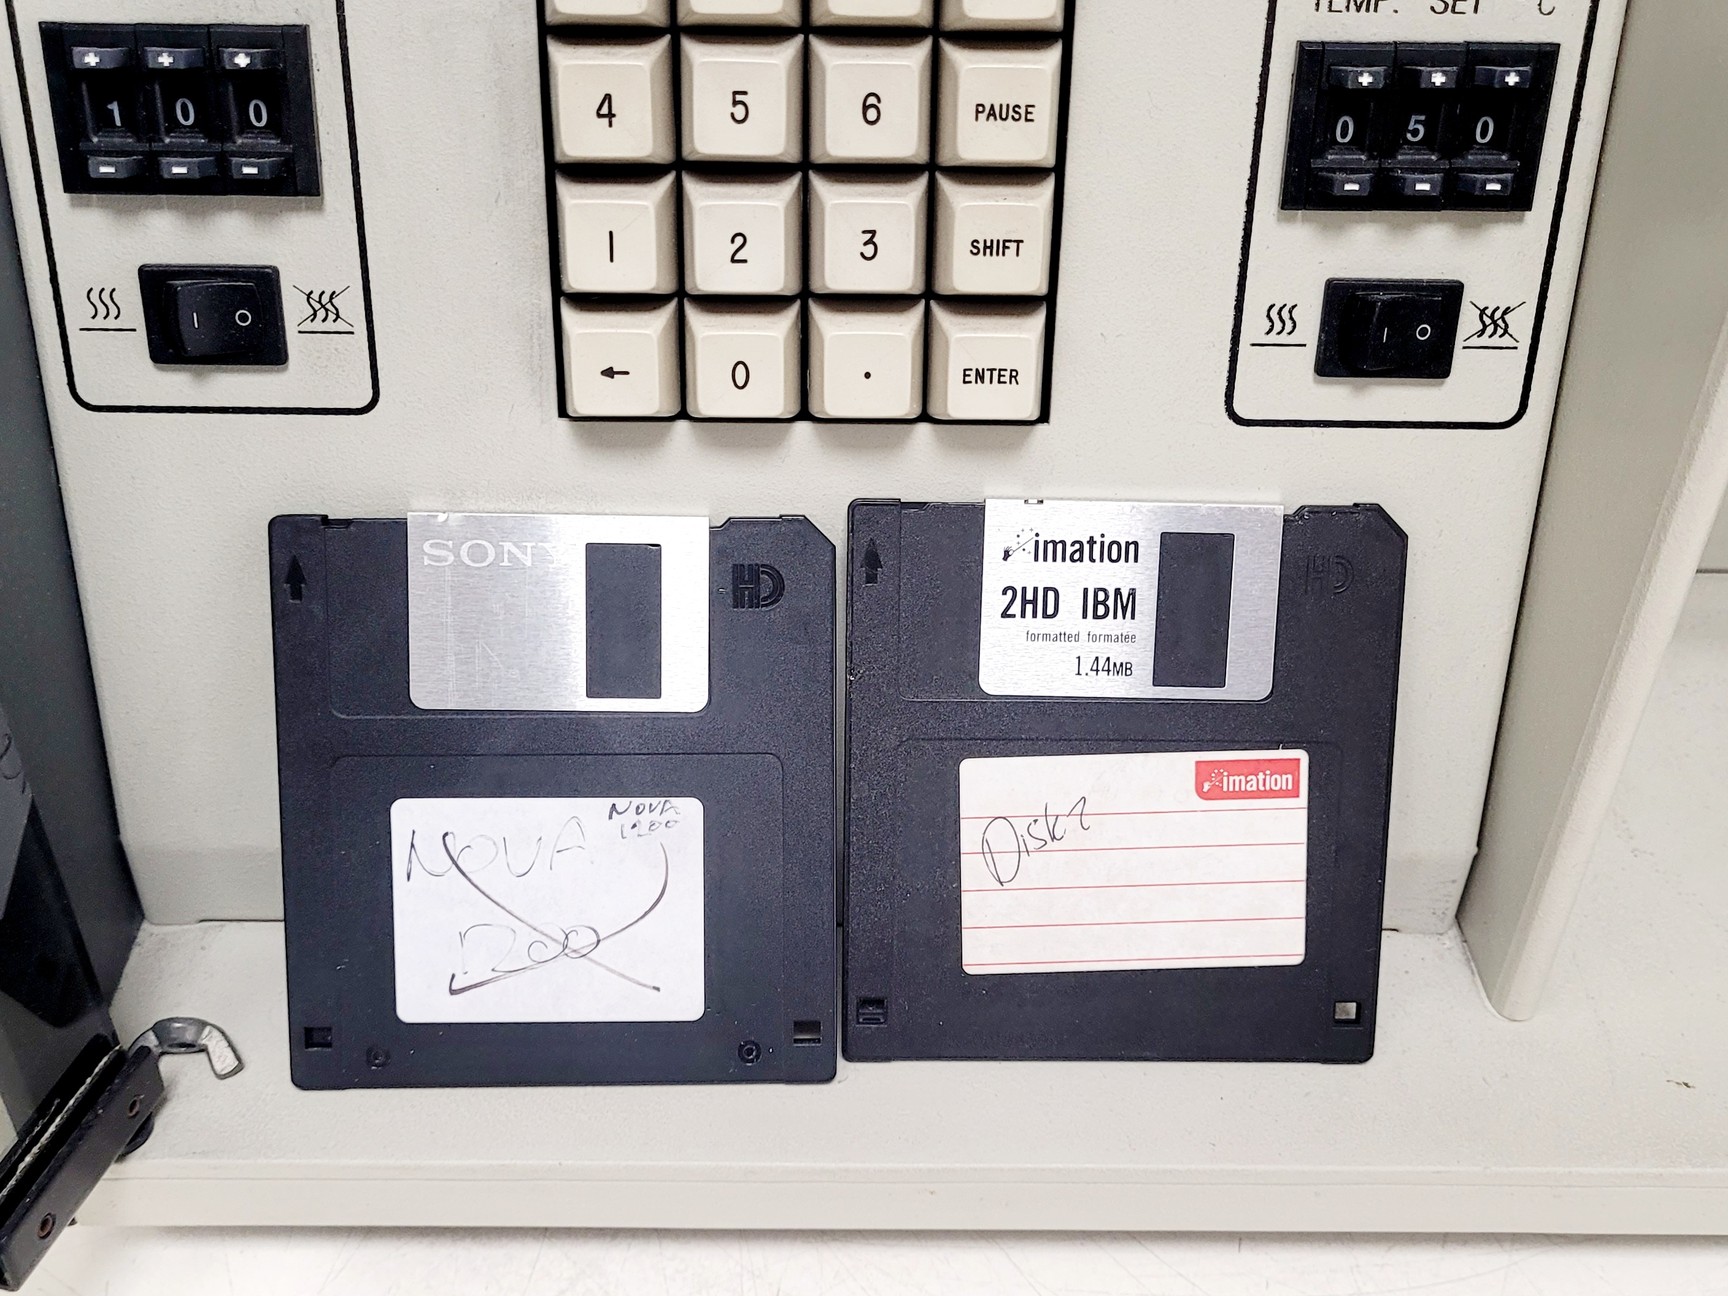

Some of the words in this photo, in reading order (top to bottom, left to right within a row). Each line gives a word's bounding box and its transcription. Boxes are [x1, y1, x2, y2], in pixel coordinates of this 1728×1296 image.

[595, 93, 617, 128] 4
[730, 90, 750, 125] 5
[861, 91, 882, 126] 6
[974, 103, 1036, 123] PAUSE
[729, 232, 749, 264] 2
[859, 229, 879, 262] 3
[969, 238, 1025, 258] SHIFT
[730, 360, 750, 390] 0
[962, 367, 1019, 386] ENTER
[1033, 532, 1140, 564] imation
[999, 585, 1060, 619] 2HD
[1081, 587, 1137, 621] IBM
[1025, 629, 1081, 643] formatted
[1087, 630, 1138, 644] formatée
[1074, 655, 1134, 677] 1.44MB
[1222, 768, 1293, 792] imation
